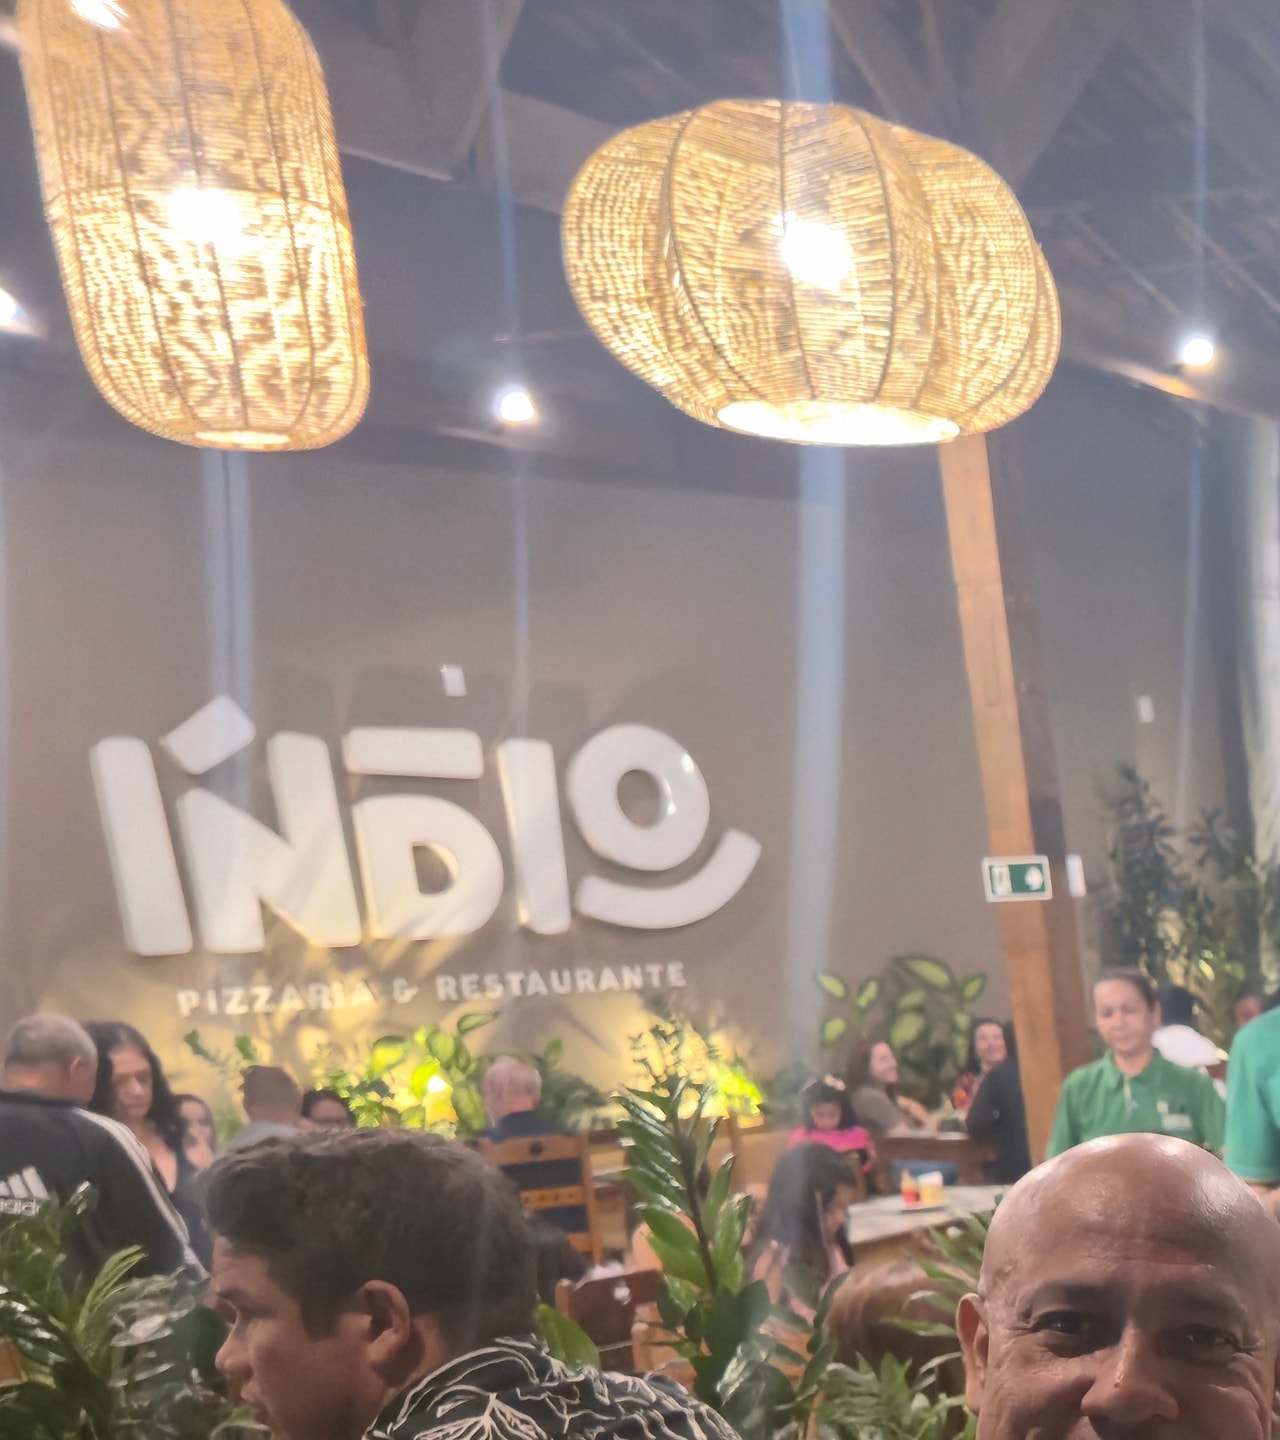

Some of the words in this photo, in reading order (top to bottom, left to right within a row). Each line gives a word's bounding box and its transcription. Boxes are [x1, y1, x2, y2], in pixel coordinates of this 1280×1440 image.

[177, 979, 376, 1018] PIZZARIA
[392, 976, 419, 1004] &
[435, 961, 687, 1002] RESTAURANTE
